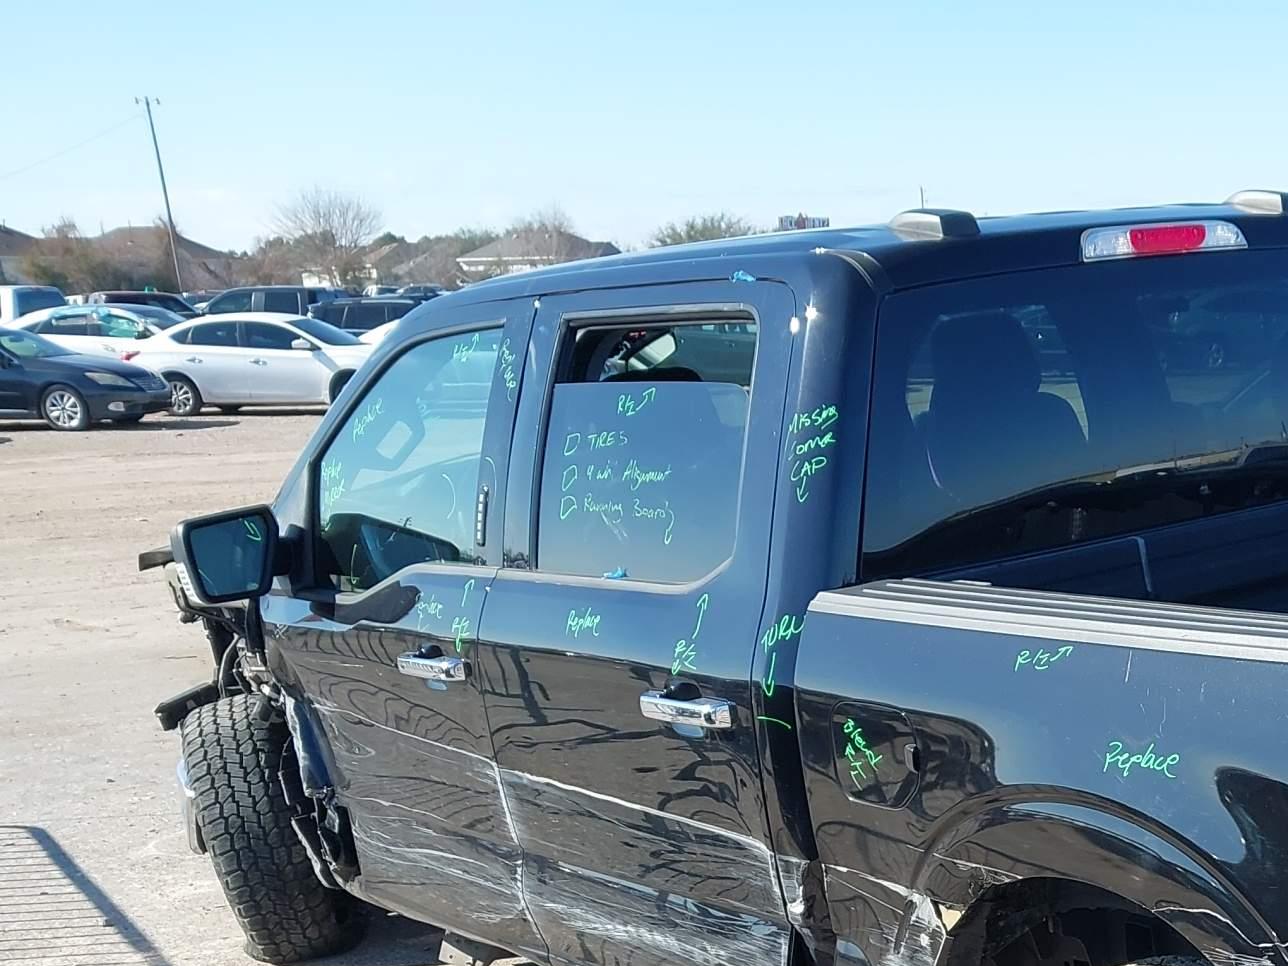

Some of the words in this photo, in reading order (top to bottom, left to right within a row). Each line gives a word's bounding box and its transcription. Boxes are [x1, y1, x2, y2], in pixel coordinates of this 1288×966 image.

[587, 430, 628, 451] TIRES
[790, 456, 827, 481] CAP
[565, 607, 601, 638] Replace
[1103, 741, 1180, 778] Replace
